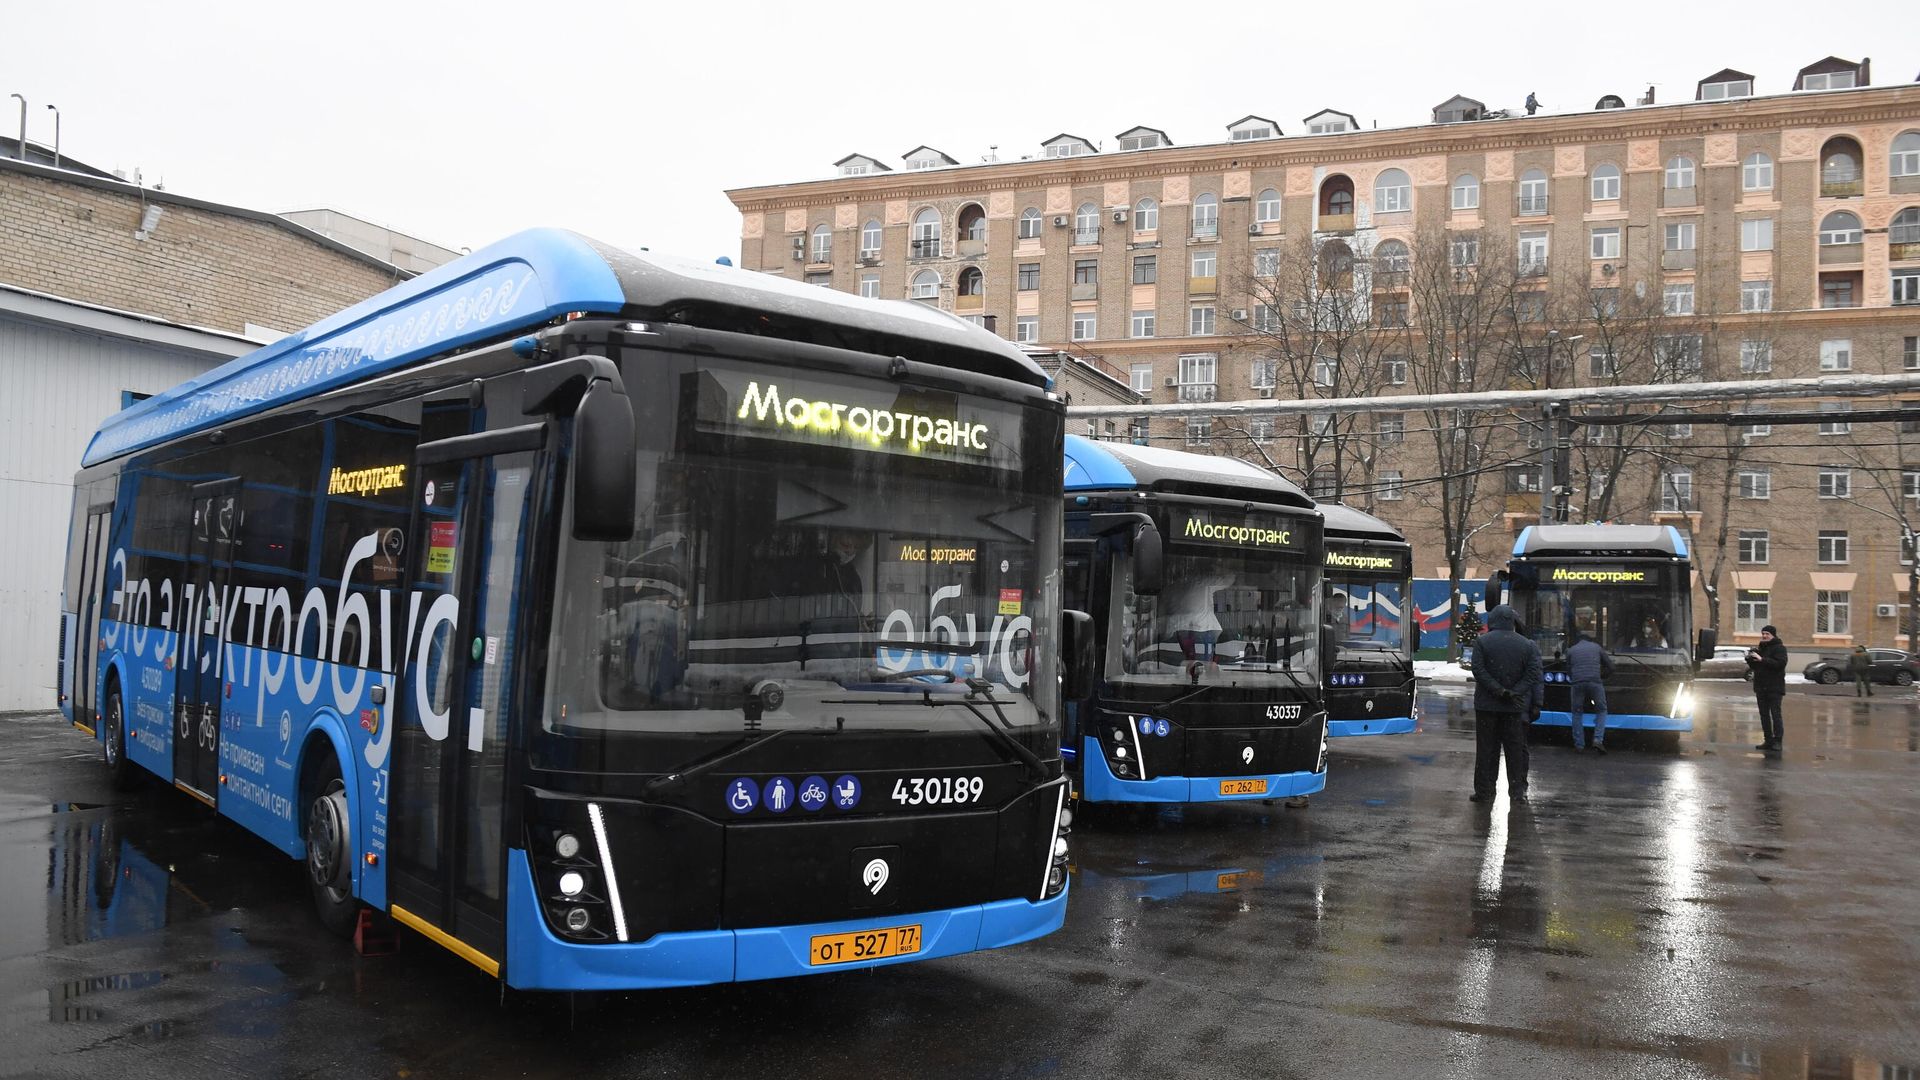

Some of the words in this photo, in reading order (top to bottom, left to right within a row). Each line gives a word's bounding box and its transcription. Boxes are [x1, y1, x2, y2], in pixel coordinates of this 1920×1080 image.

[738, 382, 988, 449] Мосгортранс
[327, 464, 406, 497] Мосгортранс
[1185, 518, 1290, 546] Мосгортранс
[900, 545, 977, 565] Мосортранс
[1326, 552, 1393, 569] Мосгортранс
[1552, 568, 1645, 583] Мосгортранс
[105, 547, 152, 657] Это
[1266, 705, 1301, 719] 430337
[218, 733, 229, 759] Не
[229, 743, 265, 776] привязан
[892, 776, 984, 805] 430189
[1237, 781, 1252, 792] 262
[1256, 780, 1265, 789] 77
[271, 793, 292, 821] сети
[820, 942, 845, 960] ОТ
[854, 932, 888, 957] 527
[899, 928, 916, 946] 77
[900, 944, 913, 952] RUS
